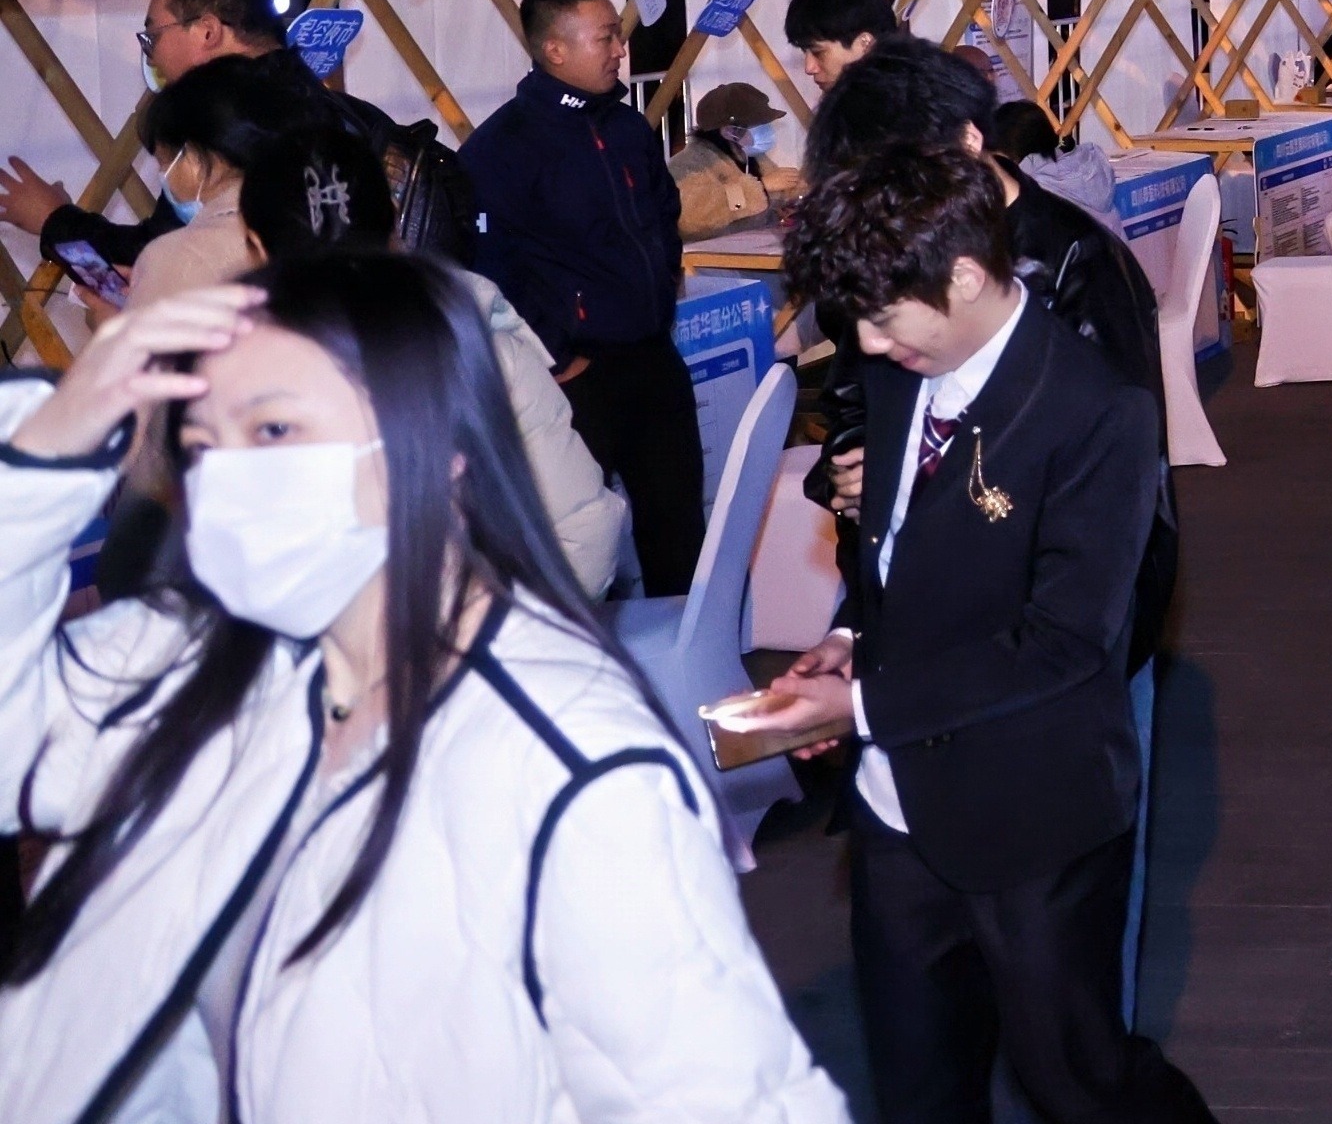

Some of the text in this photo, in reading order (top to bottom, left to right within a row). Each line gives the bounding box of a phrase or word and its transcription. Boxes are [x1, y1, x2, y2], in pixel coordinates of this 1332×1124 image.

[296, 16, 359, 48] 星空夜市
[560, 93, 587, 109] HH
